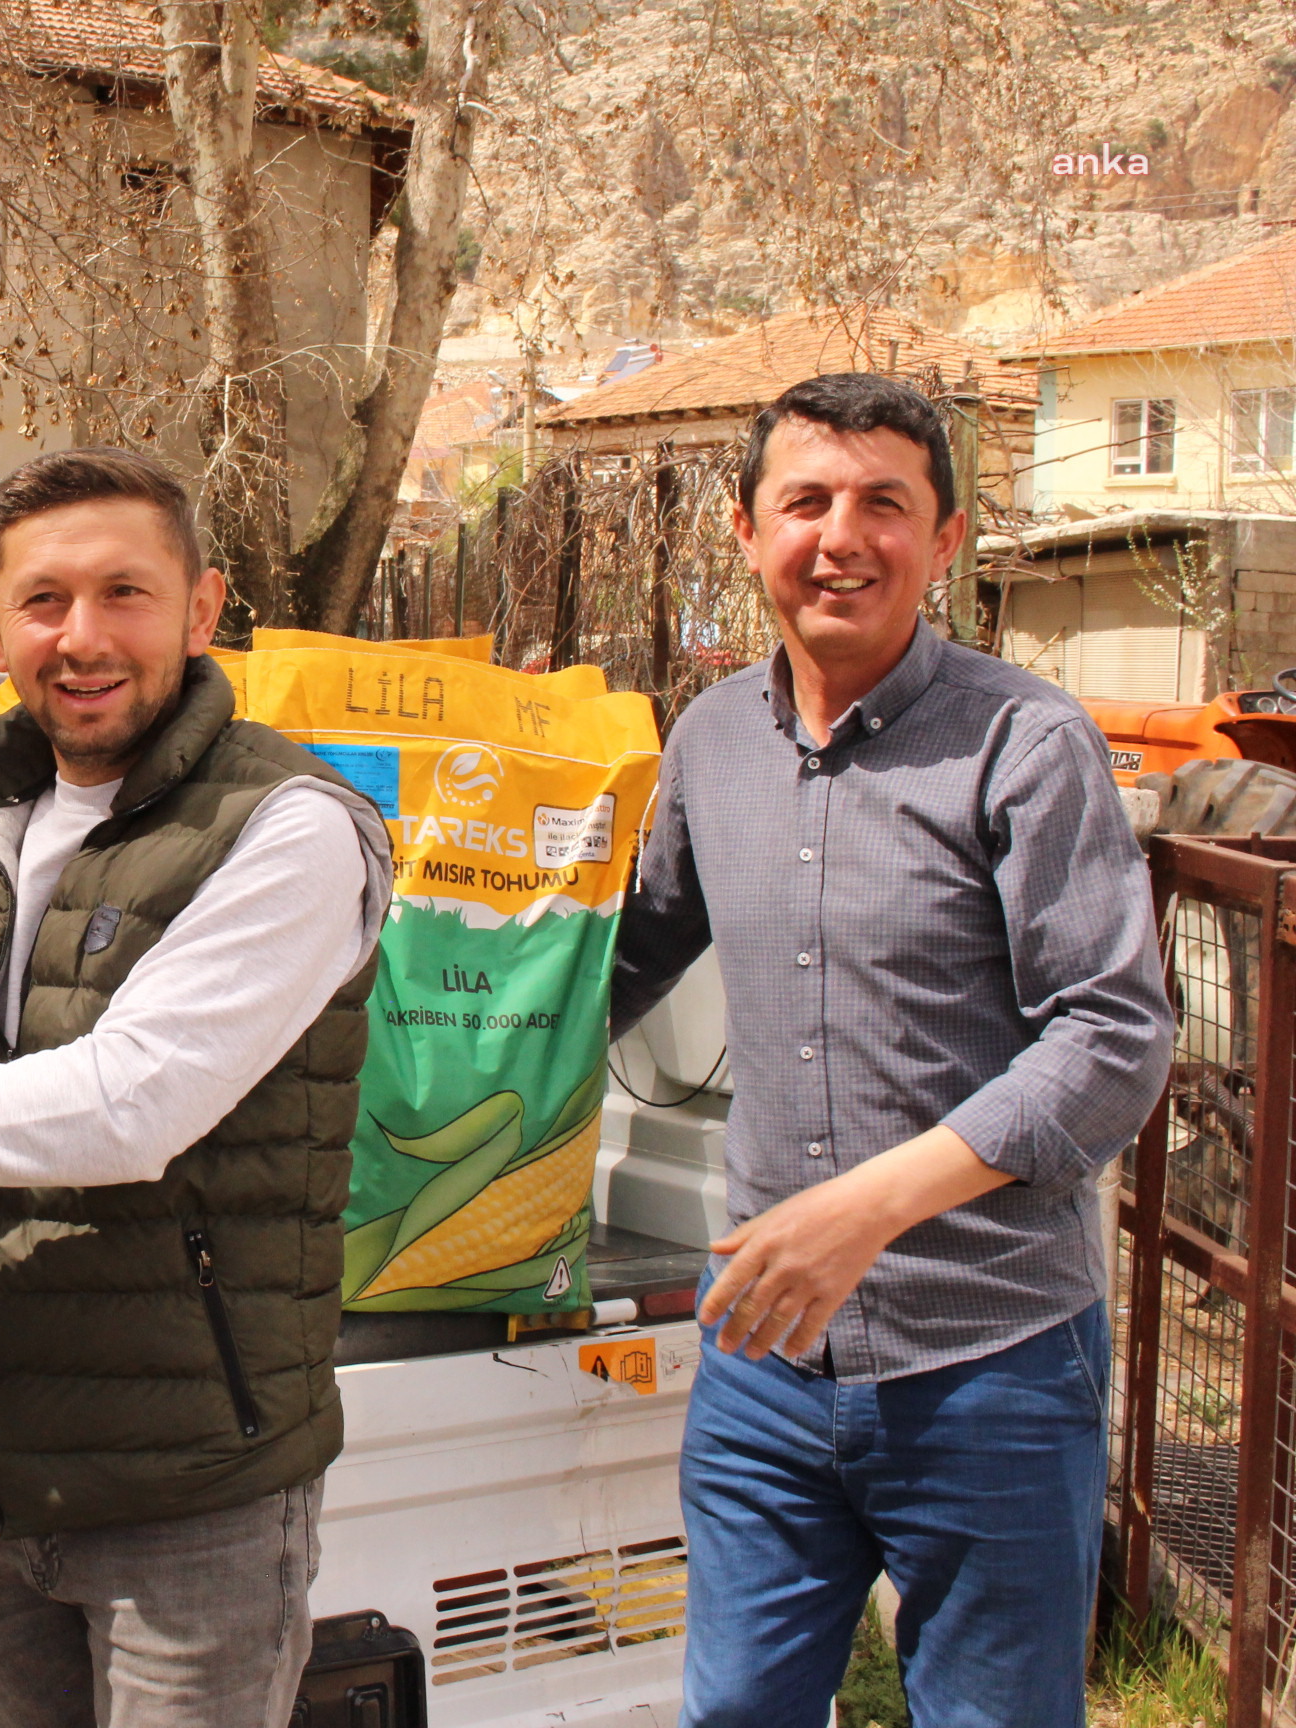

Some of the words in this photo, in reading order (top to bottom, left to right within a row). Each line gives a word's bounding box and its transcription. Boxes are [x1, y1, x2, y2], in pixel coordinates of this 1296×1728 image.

[345, 667, 444, 721] LİLA
[399, 814, 528, 858] TAREKS
[423, 860, 475, 887] MISIR
[481, 866, 579, 892] TOHUMU
[442, 964, 493, 994] LİLA
[384, 1006, 456, 1027] AKRİBEN
[462, 1013, 521, 1030] 50.000
